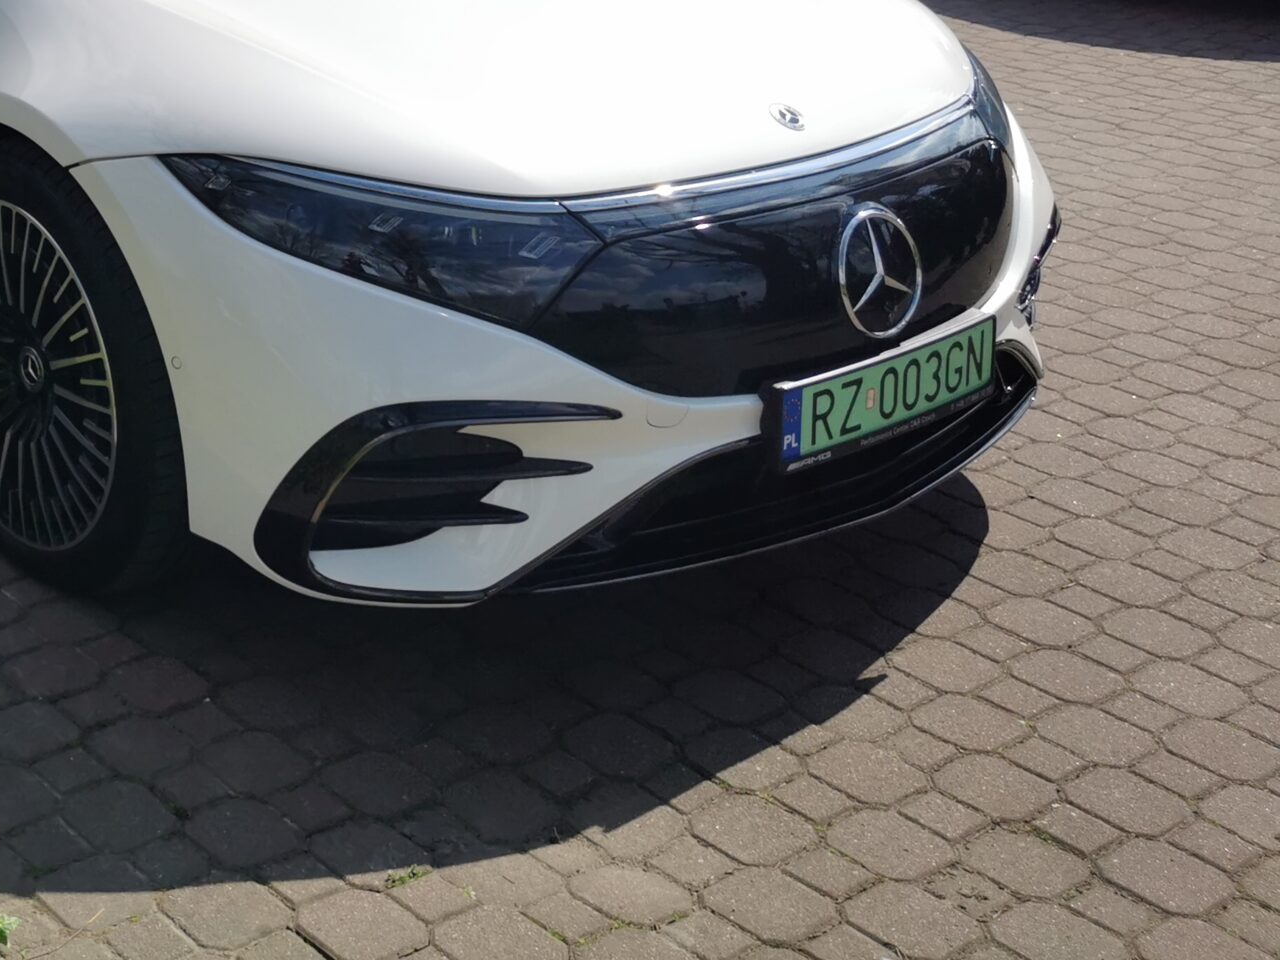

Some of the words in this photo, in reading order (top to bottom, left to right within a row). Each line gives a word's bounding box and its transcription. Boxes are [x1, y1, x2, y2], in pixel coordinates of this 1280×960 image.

[811, 377, 864, 446] RZ
[879, 329, 985, 420] 003GN
[783, 432, 799, 451] PL
